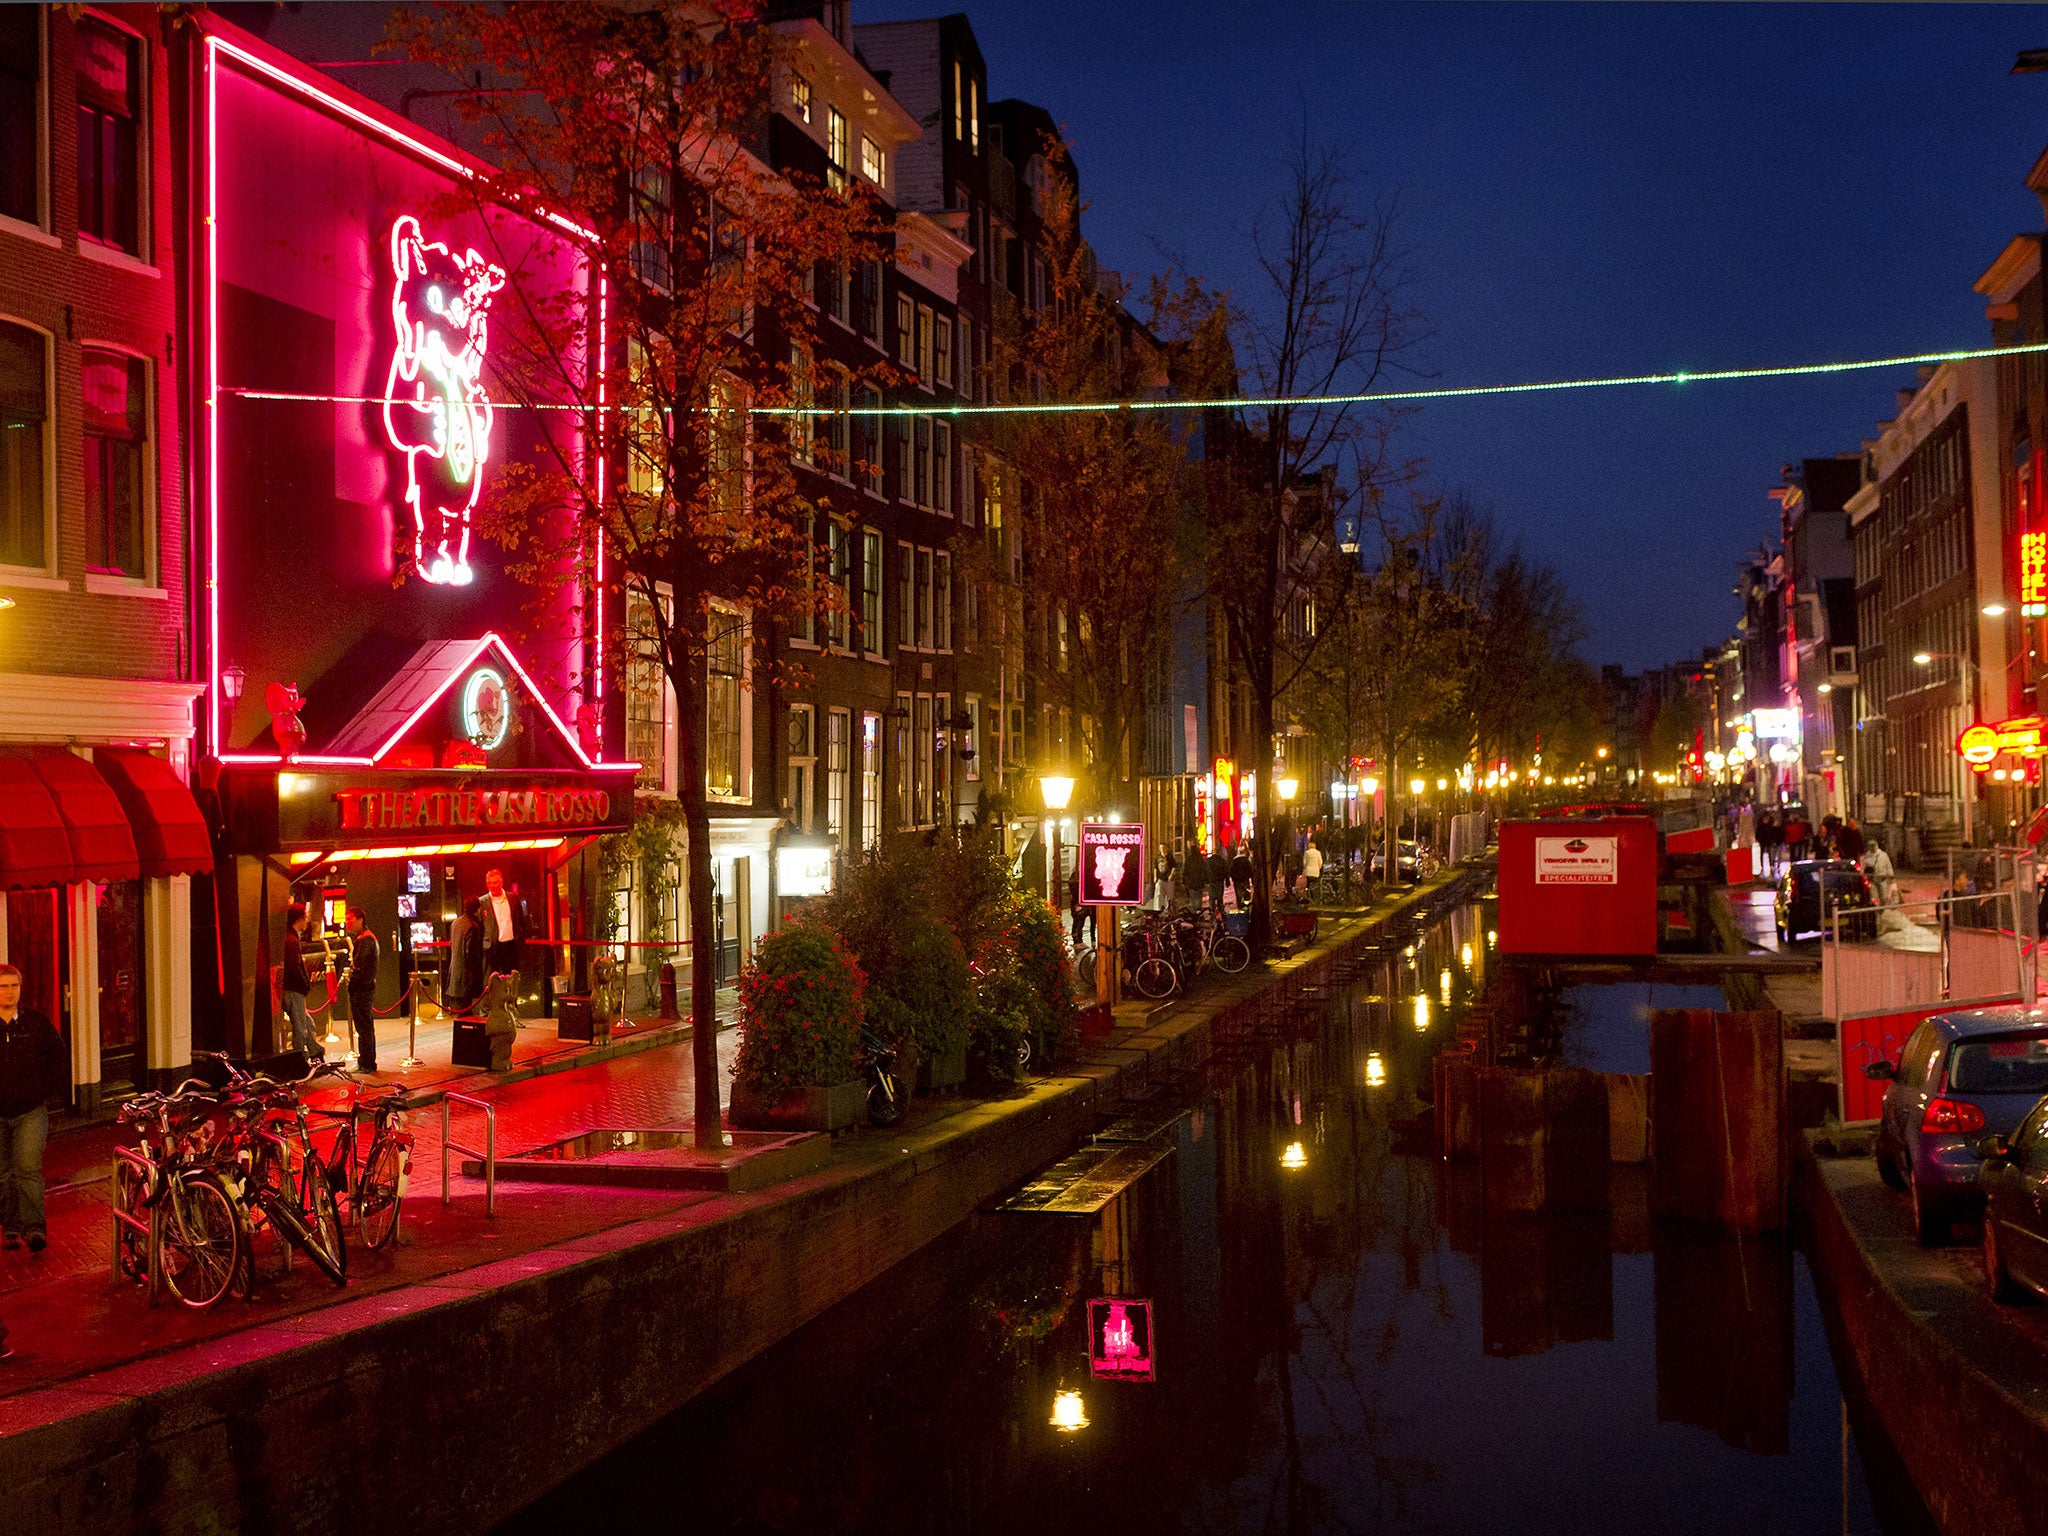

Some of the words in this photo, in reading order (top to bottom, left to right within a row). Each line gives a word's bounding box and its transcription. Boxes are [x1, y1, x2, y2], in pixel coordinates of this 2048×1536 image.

[2030, 532, 2046, 602] HOTEL
[361, 792, 476, 829] THEATRE
[486, 791, 541, 824] CASA
[546, 791, 610, 822] ROSSO
[1084, 833, 1108, 844] CASA
[1110, 834, 1140, 844] ROSSO
